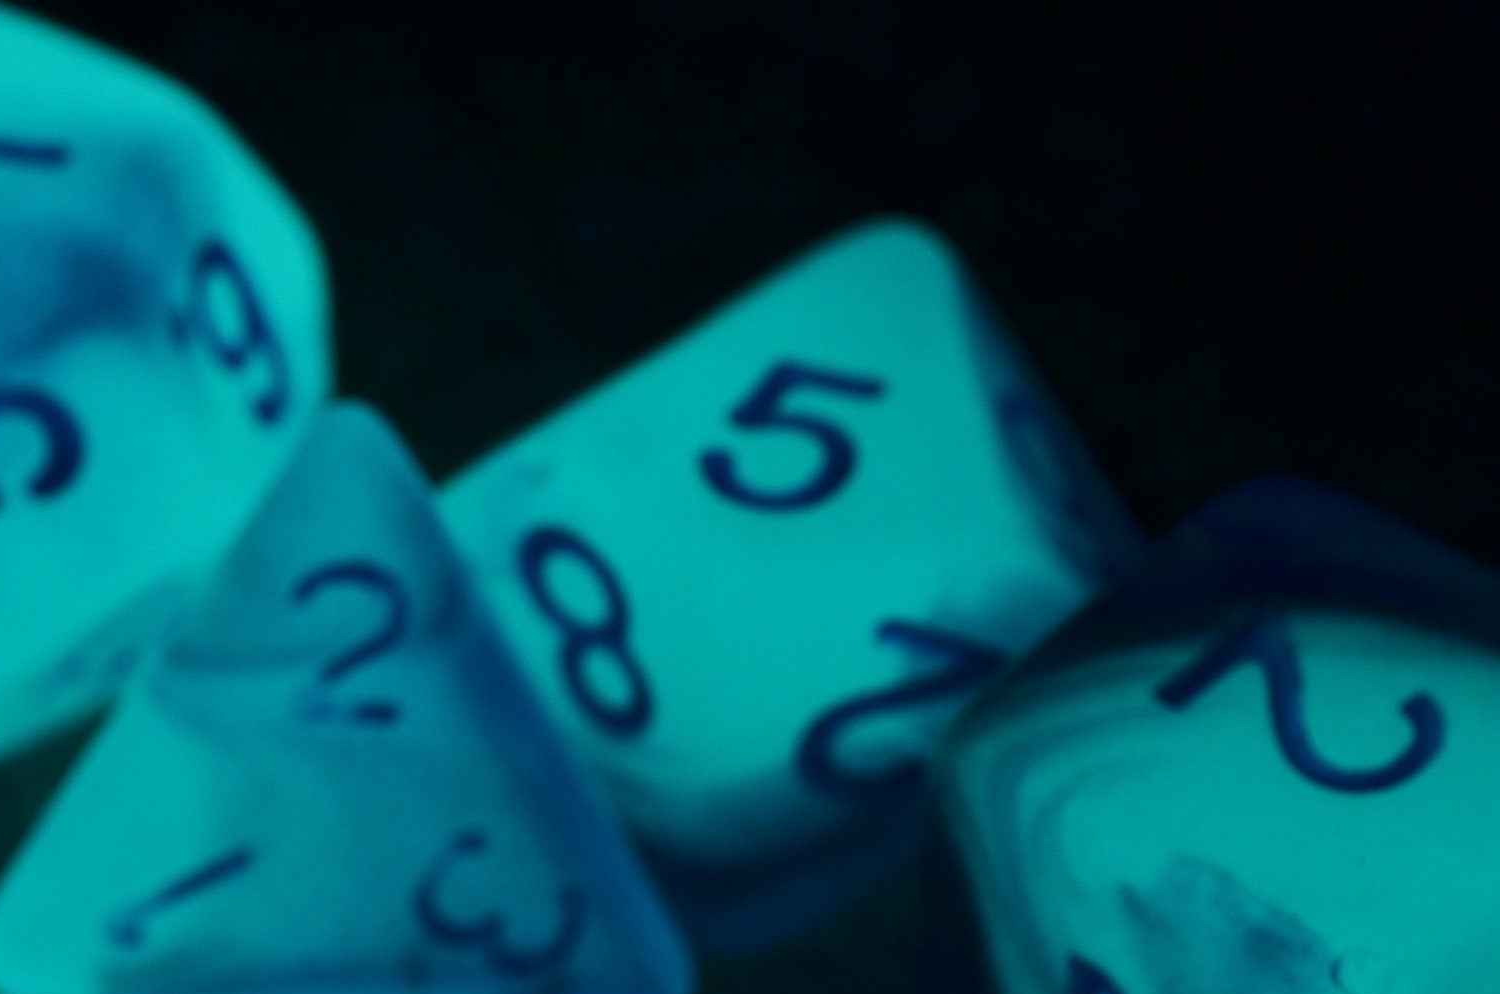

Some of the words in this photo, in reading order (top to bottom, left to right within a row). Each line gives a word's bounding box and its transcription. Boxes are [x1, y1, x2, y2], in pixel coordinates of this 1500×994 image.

[698, 358, 885, 512] 5
[295, 558, 407, 727] 2
[515, 524, 653, 738] 8
[797, 618, 1005, 802] 2
[1153, 612, 1445, 795] 2
[415, 828, 582, 975] 3
